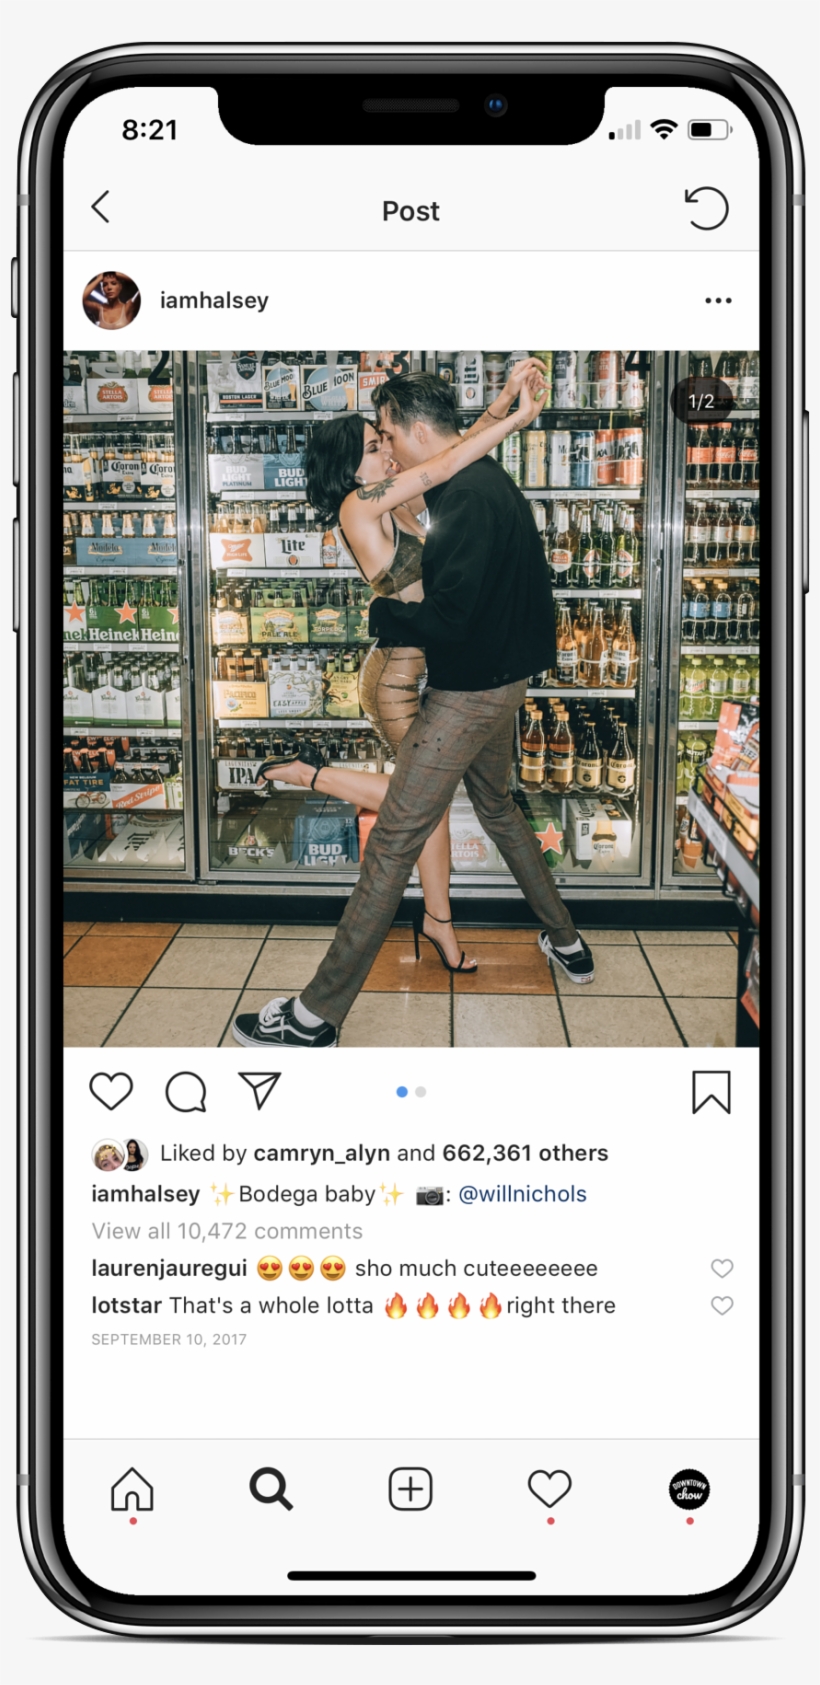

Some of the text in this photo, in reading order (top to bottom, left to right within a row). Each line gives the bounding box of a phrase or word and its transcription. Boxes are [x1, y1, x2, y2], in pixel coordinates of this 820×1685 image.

[122, 119, 176, 141] 8:21
[383, 201, 440, 222] Post
[161, 291, 269, 313] iamhalsey
[302, 382, 328, 400] BLUE
[689, 394, 714, 411] 1/2
[222, 473, 252, 481] LIGHT
[225, 465, 248, 473] BUD
[278, 468, 305, 478] BUD
[281, 540, 306, 554] Lite
[228, 767, 257, 784] IPA
[308, 843, 343, 855] BUD
[161, 1143, 609, 1166] Liked by camryn_alyn and 662,361 others
[92, 1184, 200, 1206] iamhalsey
[240, 1185, 318, 1206] Bodega
[325, 1185, 376, 1206] baby
[459, 1184, 587, 1205] @willnichols
[92, 1222, 363, 1243] View all 10,472 comments
[92, 1258, 598, 1281] laurenjauregui sho much cuteeeeeeee
[92, 1296, 616, 1318] lotstar That's a whole lotta right there
[92, 1334, 247, 1348] SEPTEMBER 10, 2017
[672, 1479, 708, 1490] DOWNTOWN
[676, 1487, 704, 1500] chow
